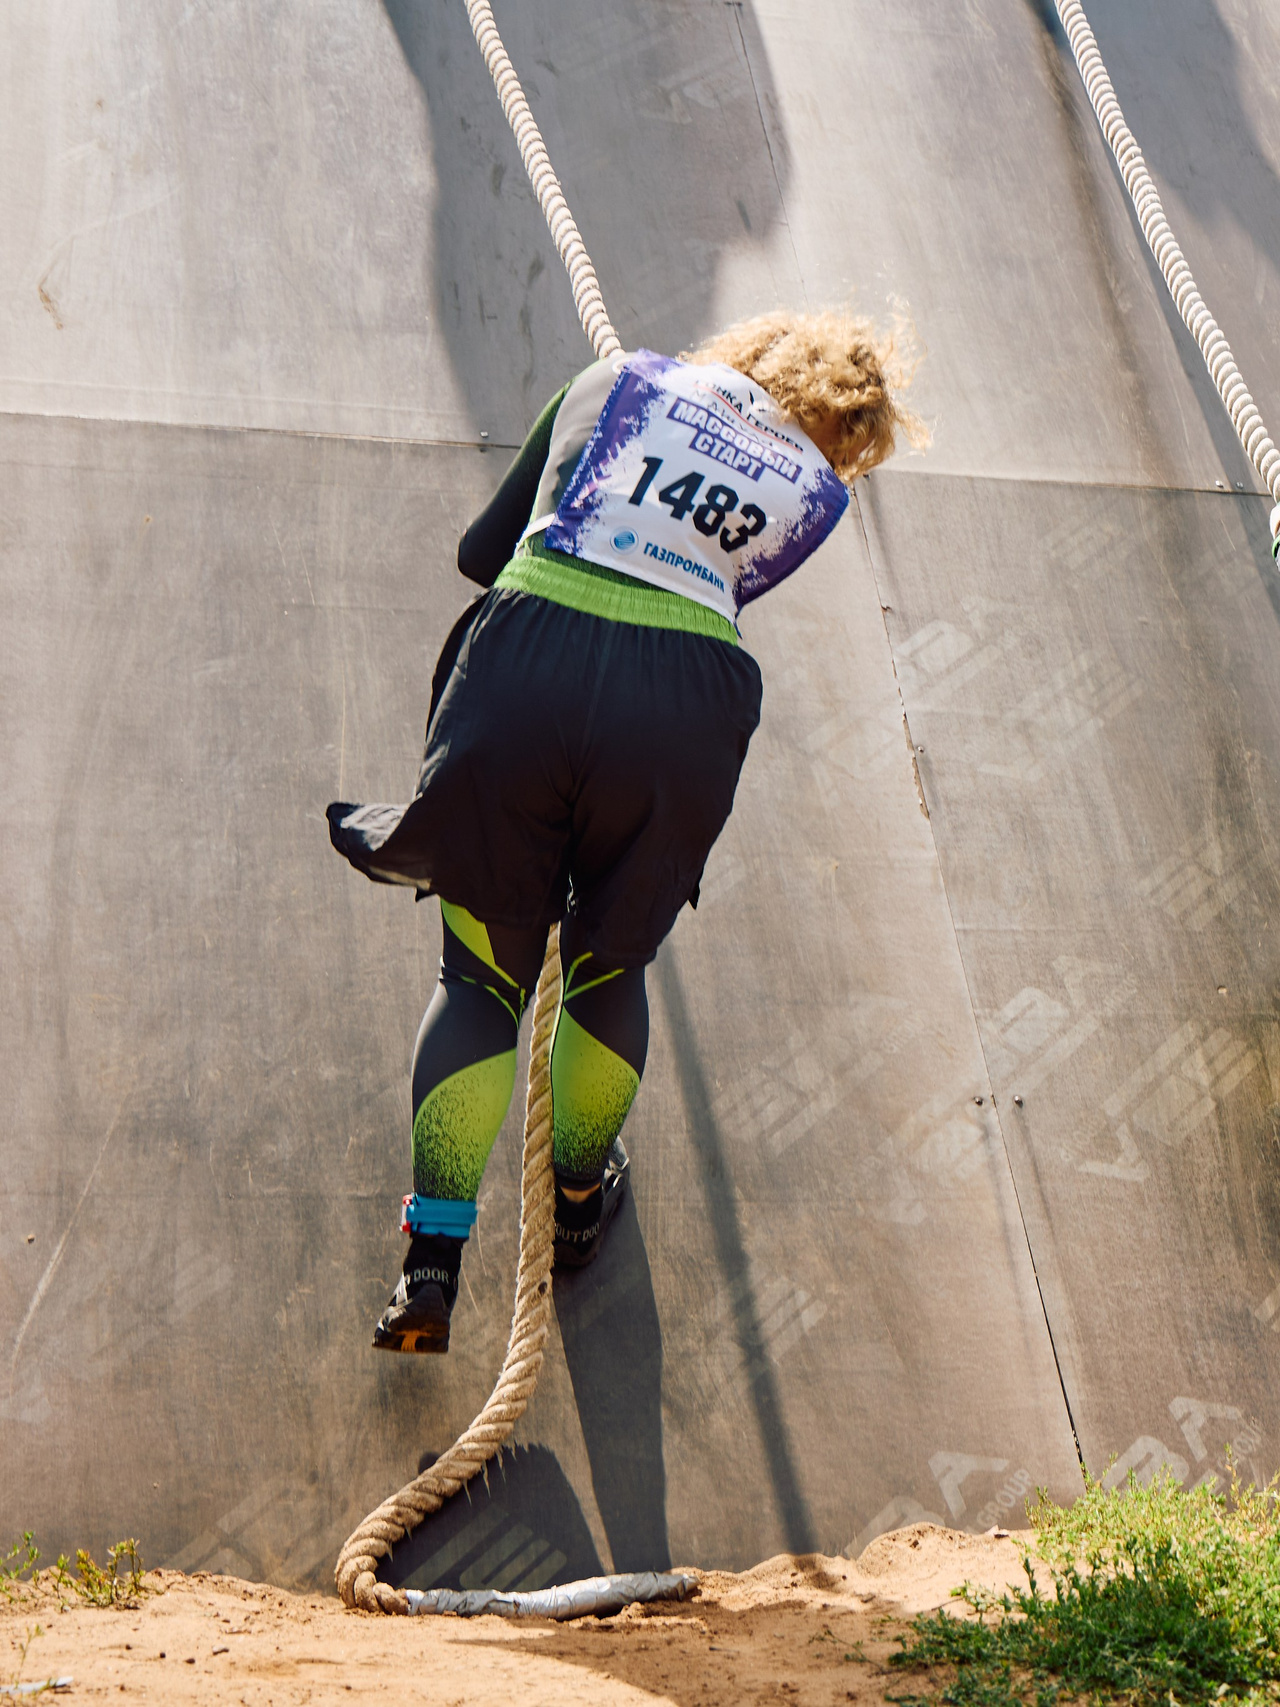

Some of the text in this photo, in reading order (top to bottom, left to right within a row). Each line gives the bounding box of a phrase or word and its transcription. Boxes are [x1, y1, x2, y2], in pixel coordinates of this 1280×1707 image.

[695, 433, 764, 479] СТАРТ
[628, 456, 767, 553] 1483
[643, 542, 726, 593] ГАЗПРОМБАНК
